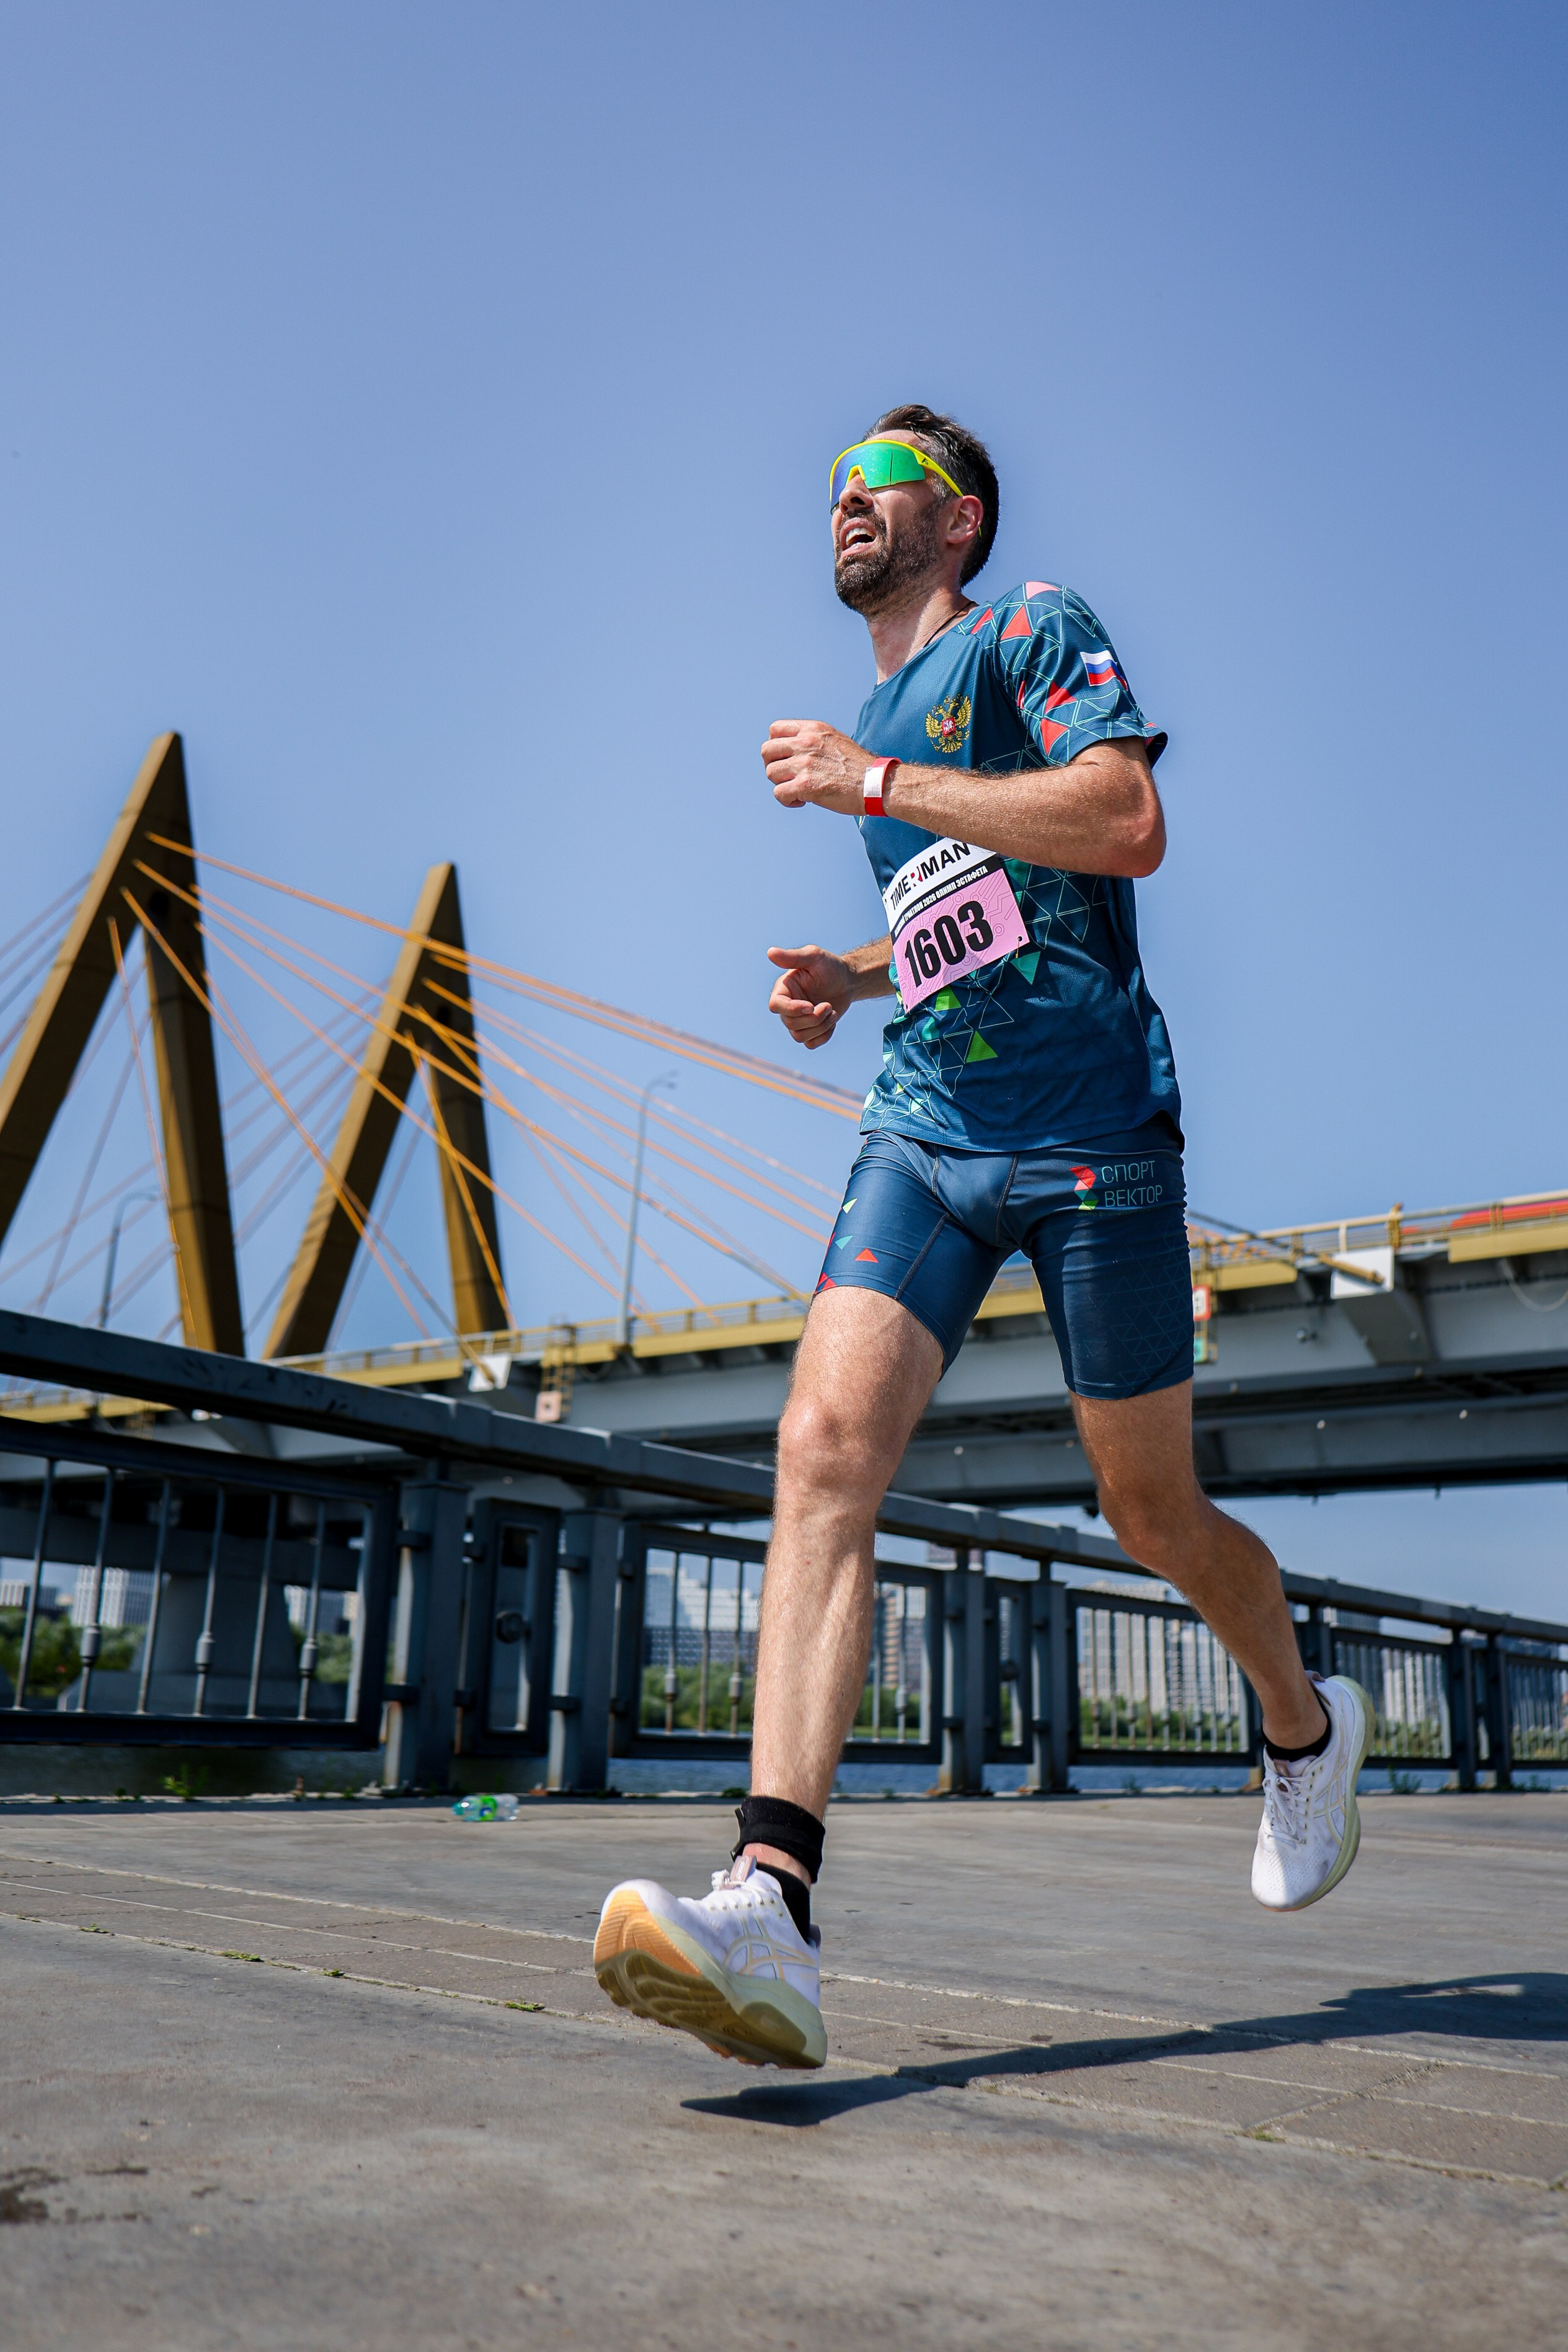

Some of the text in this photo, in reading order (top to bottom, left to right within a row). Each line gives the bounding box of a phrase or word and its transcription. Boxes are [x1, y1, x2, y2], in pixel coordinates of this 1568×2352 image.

[904, 866, 988, 922] ТРИАТЛОН 2026 ОЛИМП ЭСТАФЕТА
[905, 900, 994, 988] 1603
[1101, 1161, 1155, 1183] СПОРТ
[1104, 1185, 1163, 1207] ВЕКТОР
